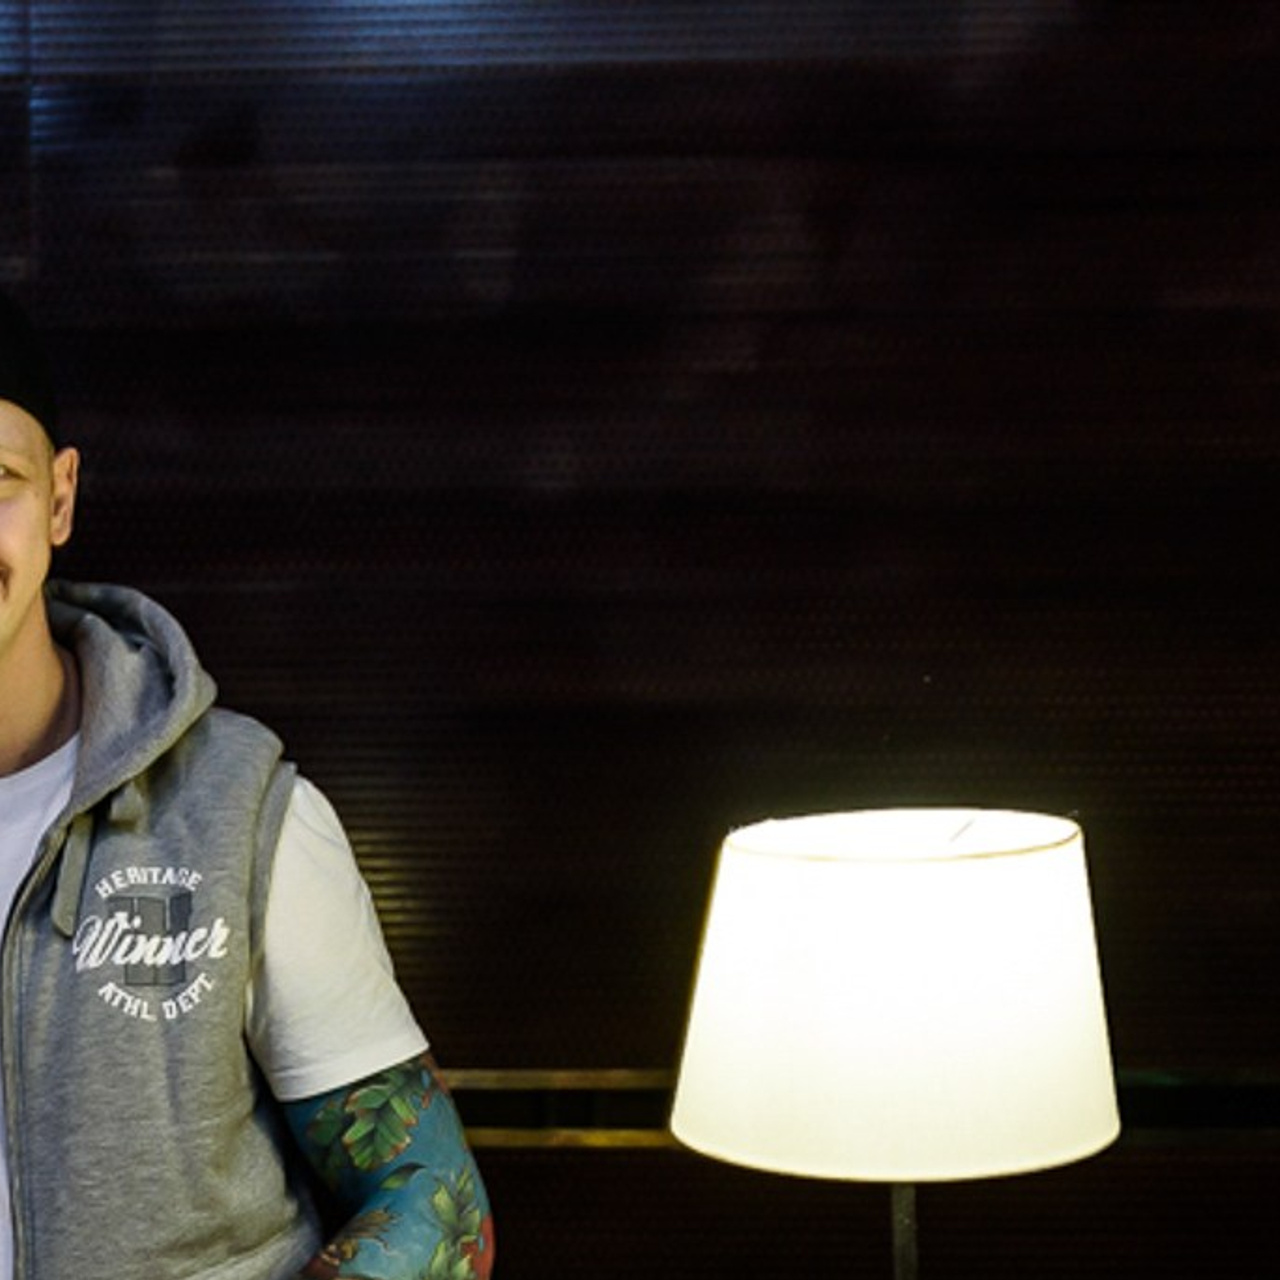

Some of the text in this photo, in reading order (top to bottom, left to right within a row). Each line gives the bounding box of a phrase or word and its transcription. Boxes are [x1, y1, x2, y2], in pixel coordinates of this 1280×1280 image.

[95, 867, 203, 899] HERITAGE
[72, 912, 230, 972] Winner
[98, 972, 215, 1022] ATHL DEPT
